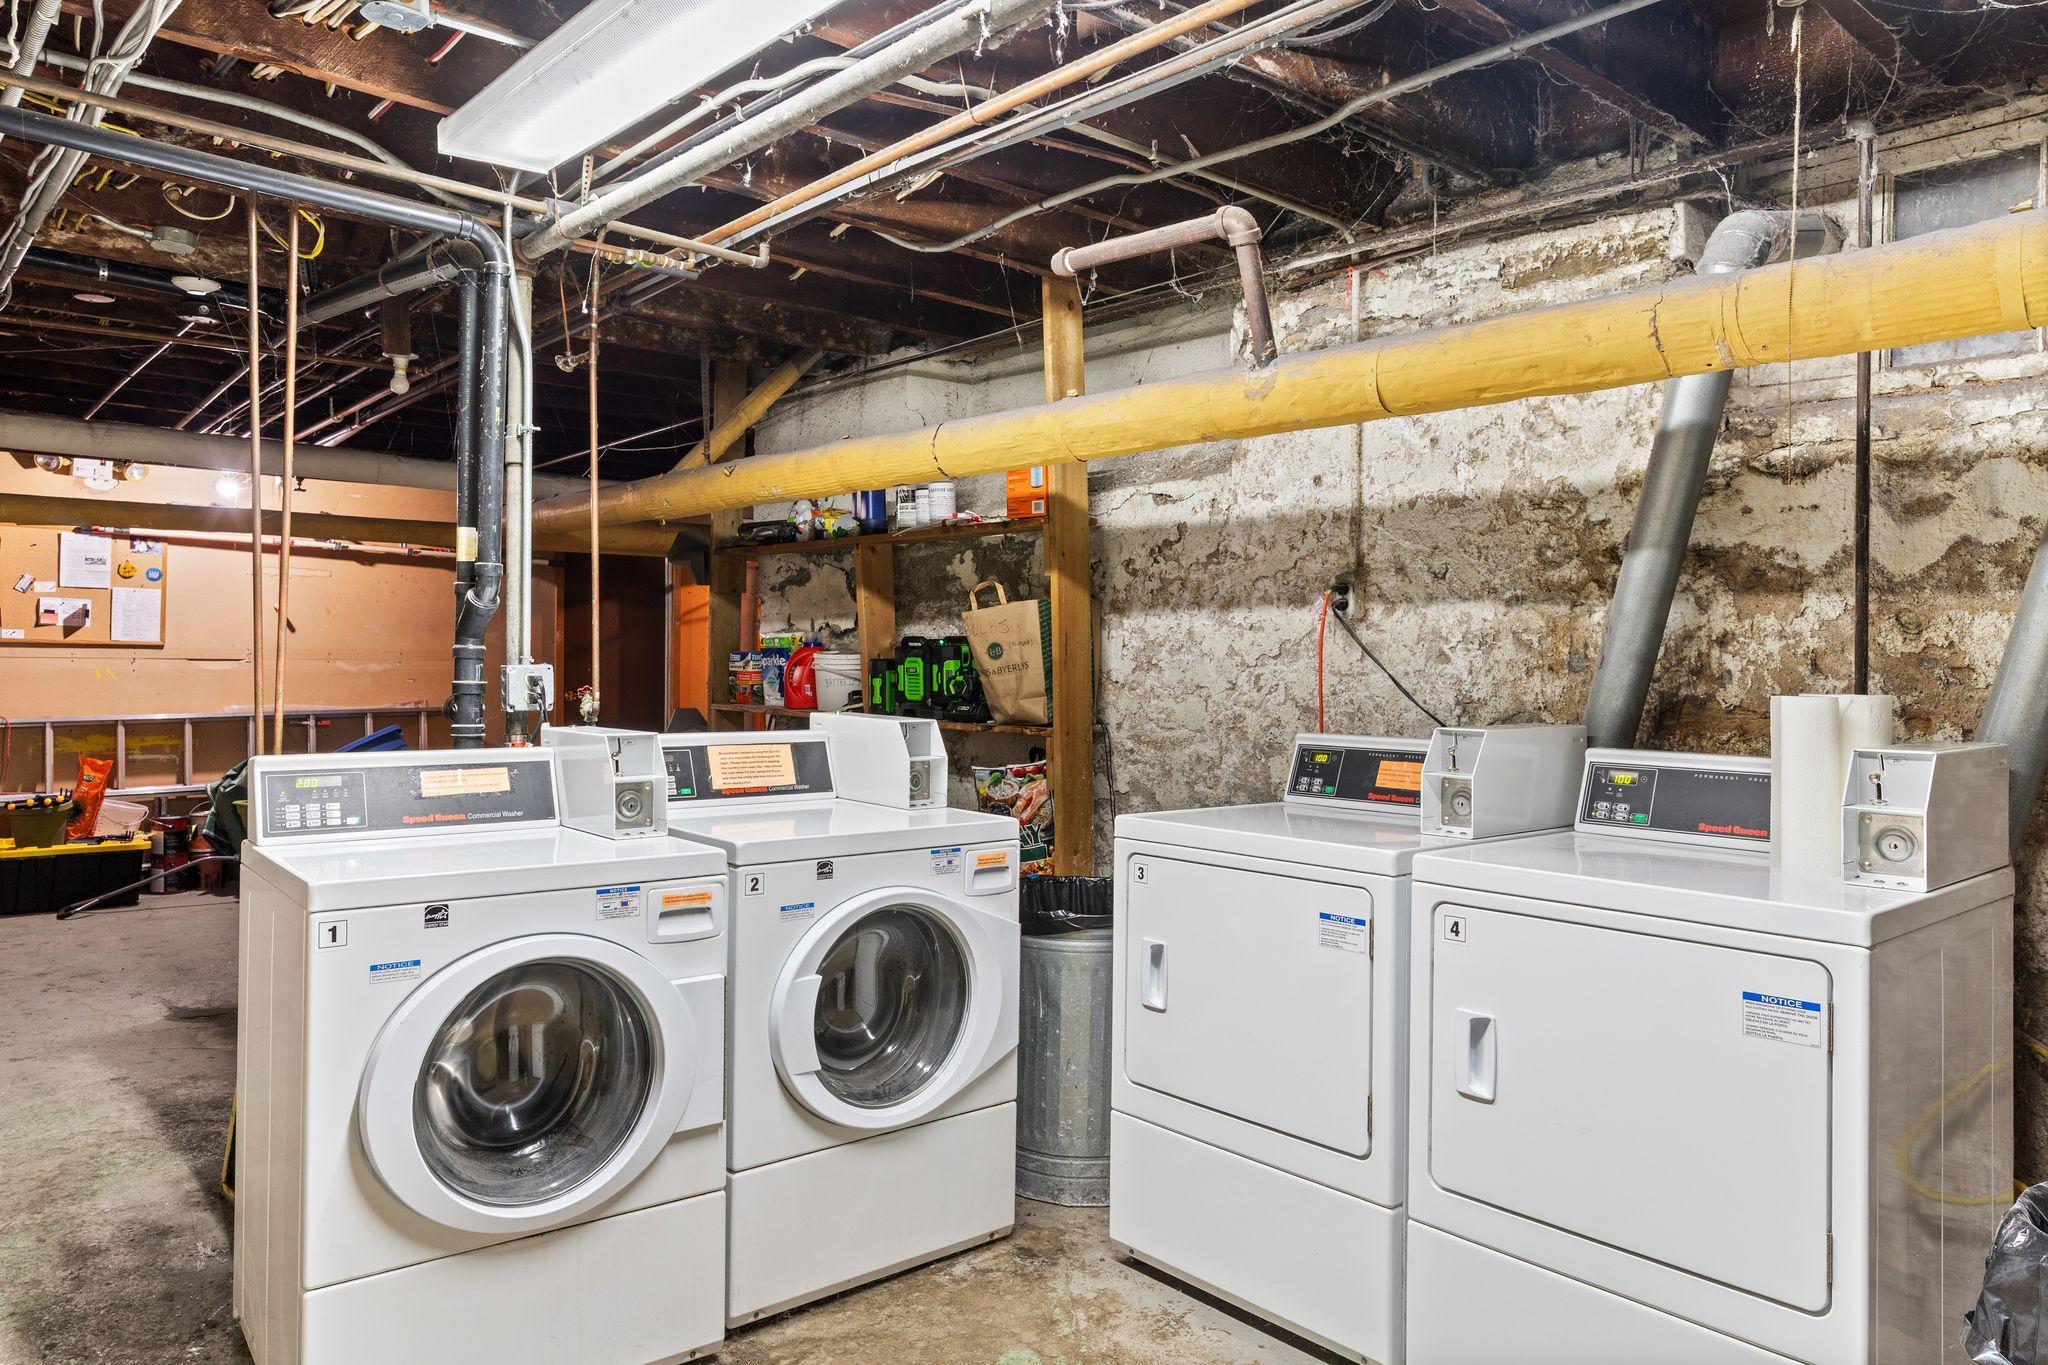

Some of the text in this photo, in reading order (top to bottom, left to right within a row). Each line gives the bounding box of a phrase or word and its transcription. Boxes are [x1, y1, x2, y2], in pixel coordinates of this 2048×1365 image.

[1315, 754, 1328, 763] 100
[1614, 775, 1632, 784] 100
[1367, 792, 1391, 802] Speed
[1391, 794, 1414, 803] Queen
[402, 810, 524, 825] Speed Queen Commercial Washer
[1698, 822, 1768, 837] Speed Queen
[1138, 866, 1144, 880] 3
[750, 877, 759, 892] 2
[1330, 914, 1355, 924] NOTICE
[327, 925, 337, 943] 1
[1450, 920, 1460, 937] 4
[378, 961, 412, 970] NOTICE
[1761, 995, 1803, 1008] NOTICE
